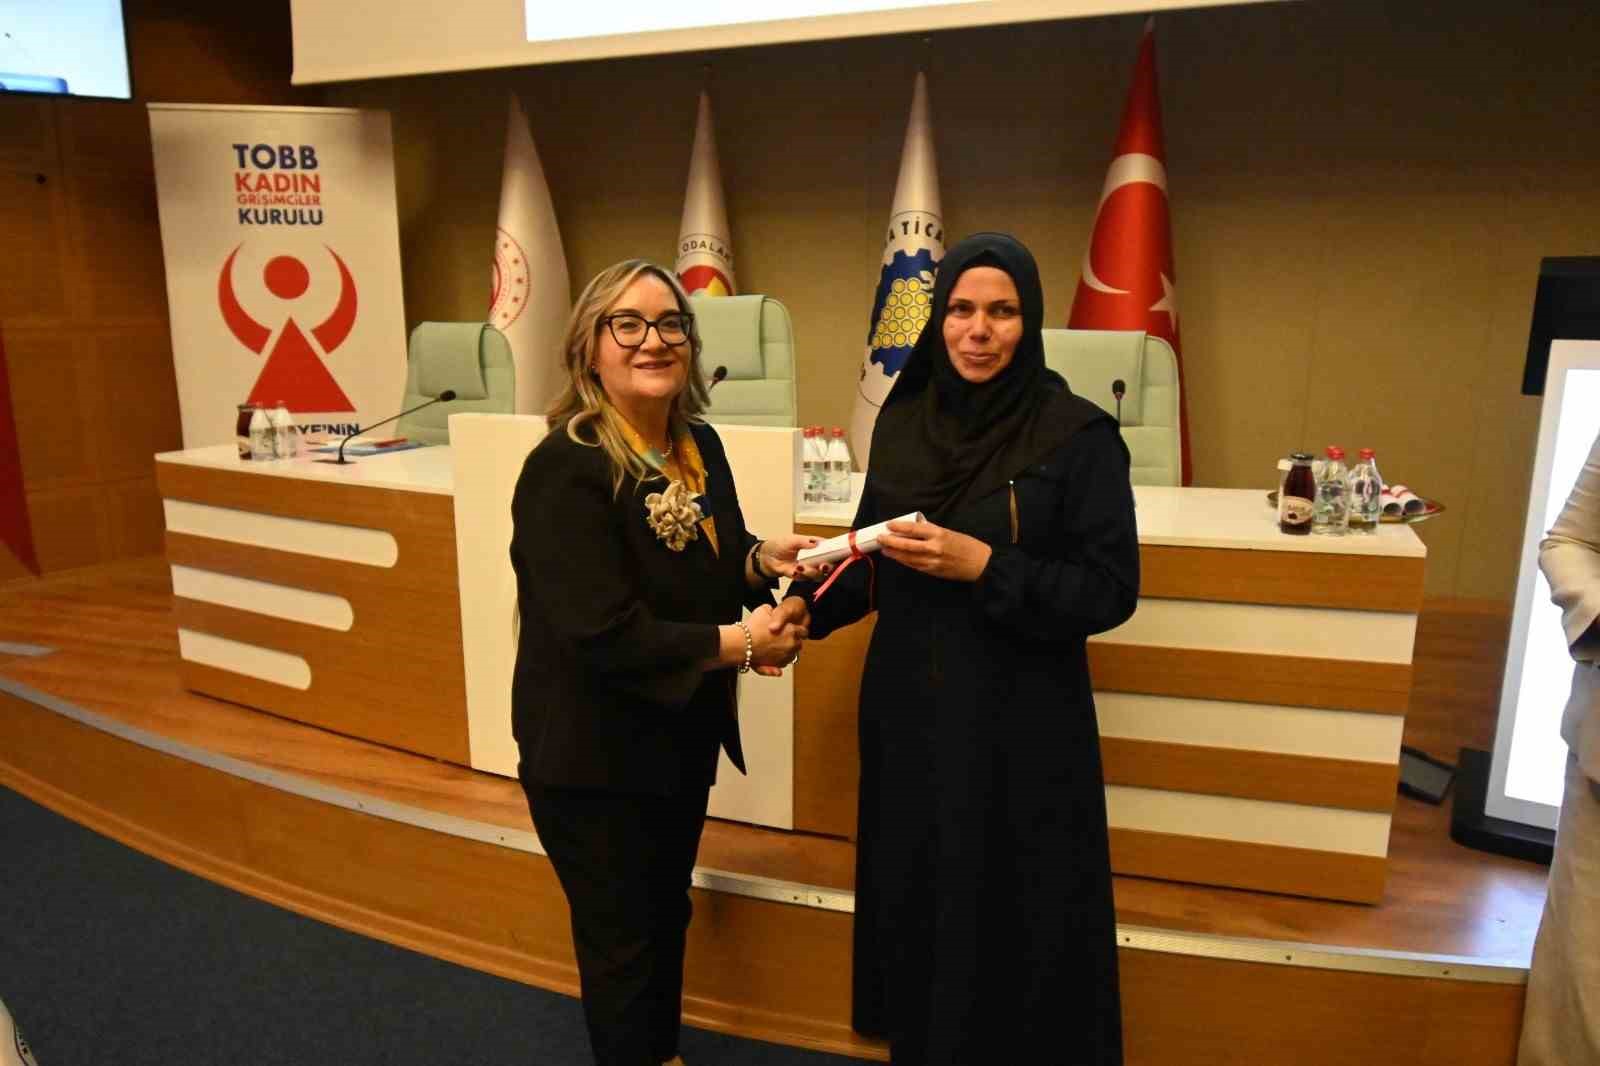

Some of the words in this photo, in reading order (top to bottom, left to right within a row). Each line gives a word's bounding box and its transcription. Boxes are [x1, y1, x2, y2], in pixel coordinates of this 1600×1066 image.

[232, 143, 318, 169] TOBB
[234, 172, 321, 193] KADIN
[238, 207, 323, 225] KURULU
[901, 216, 944, 242] TİCA
